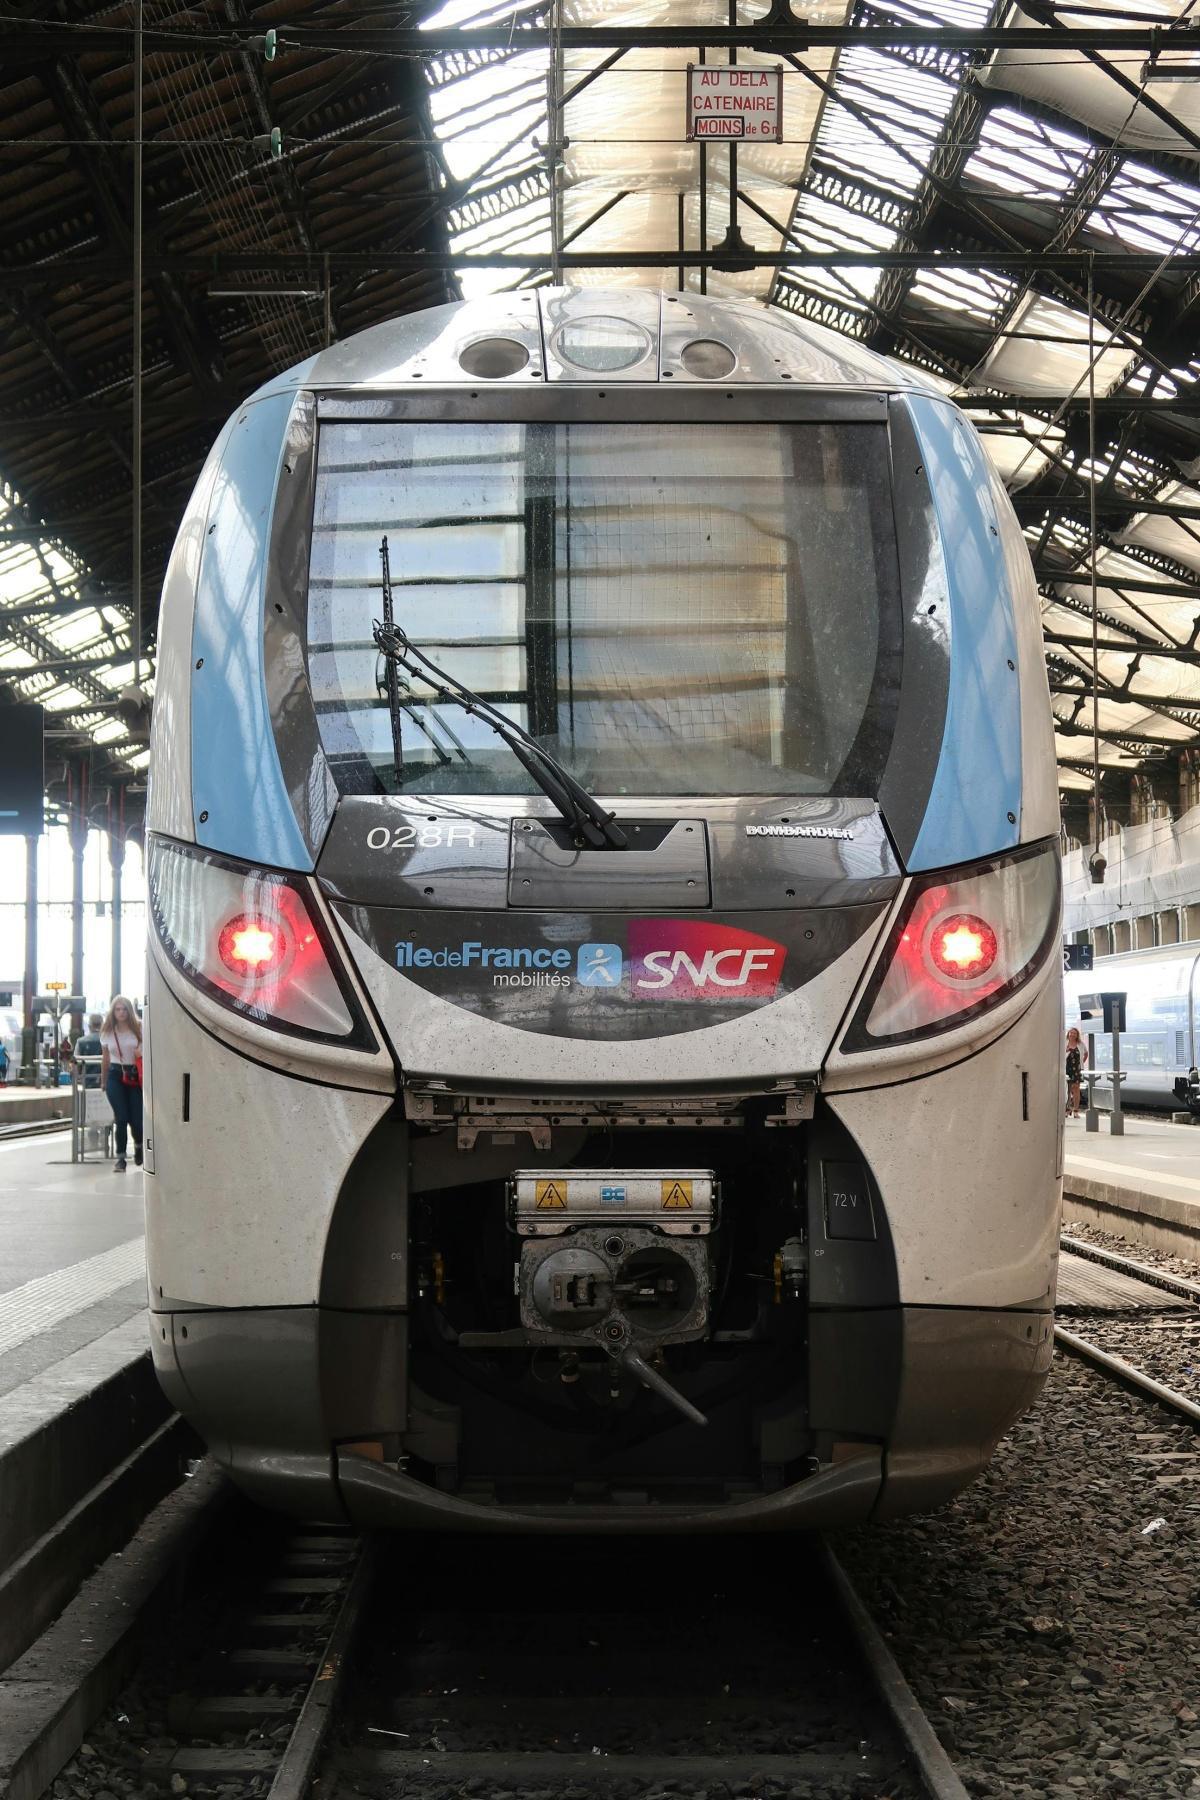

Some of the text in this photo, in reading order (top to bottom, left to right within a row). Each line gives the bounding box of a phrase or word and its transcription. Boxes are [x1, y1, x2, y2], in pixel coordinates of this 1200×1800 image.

[701, 71, 768, 86] AU DELA
[693, 95, 776, 111] CATENAIRE
[698, 119, 742, 134] MOINS
[746, 122, 756, 134] de
[366, 826, 477, 850] 028R
[745, 825, 854, 840] BOMBARDIER
[637, 949, 776, 989] SNCF
[493, 971, 571, 987] mobilités
